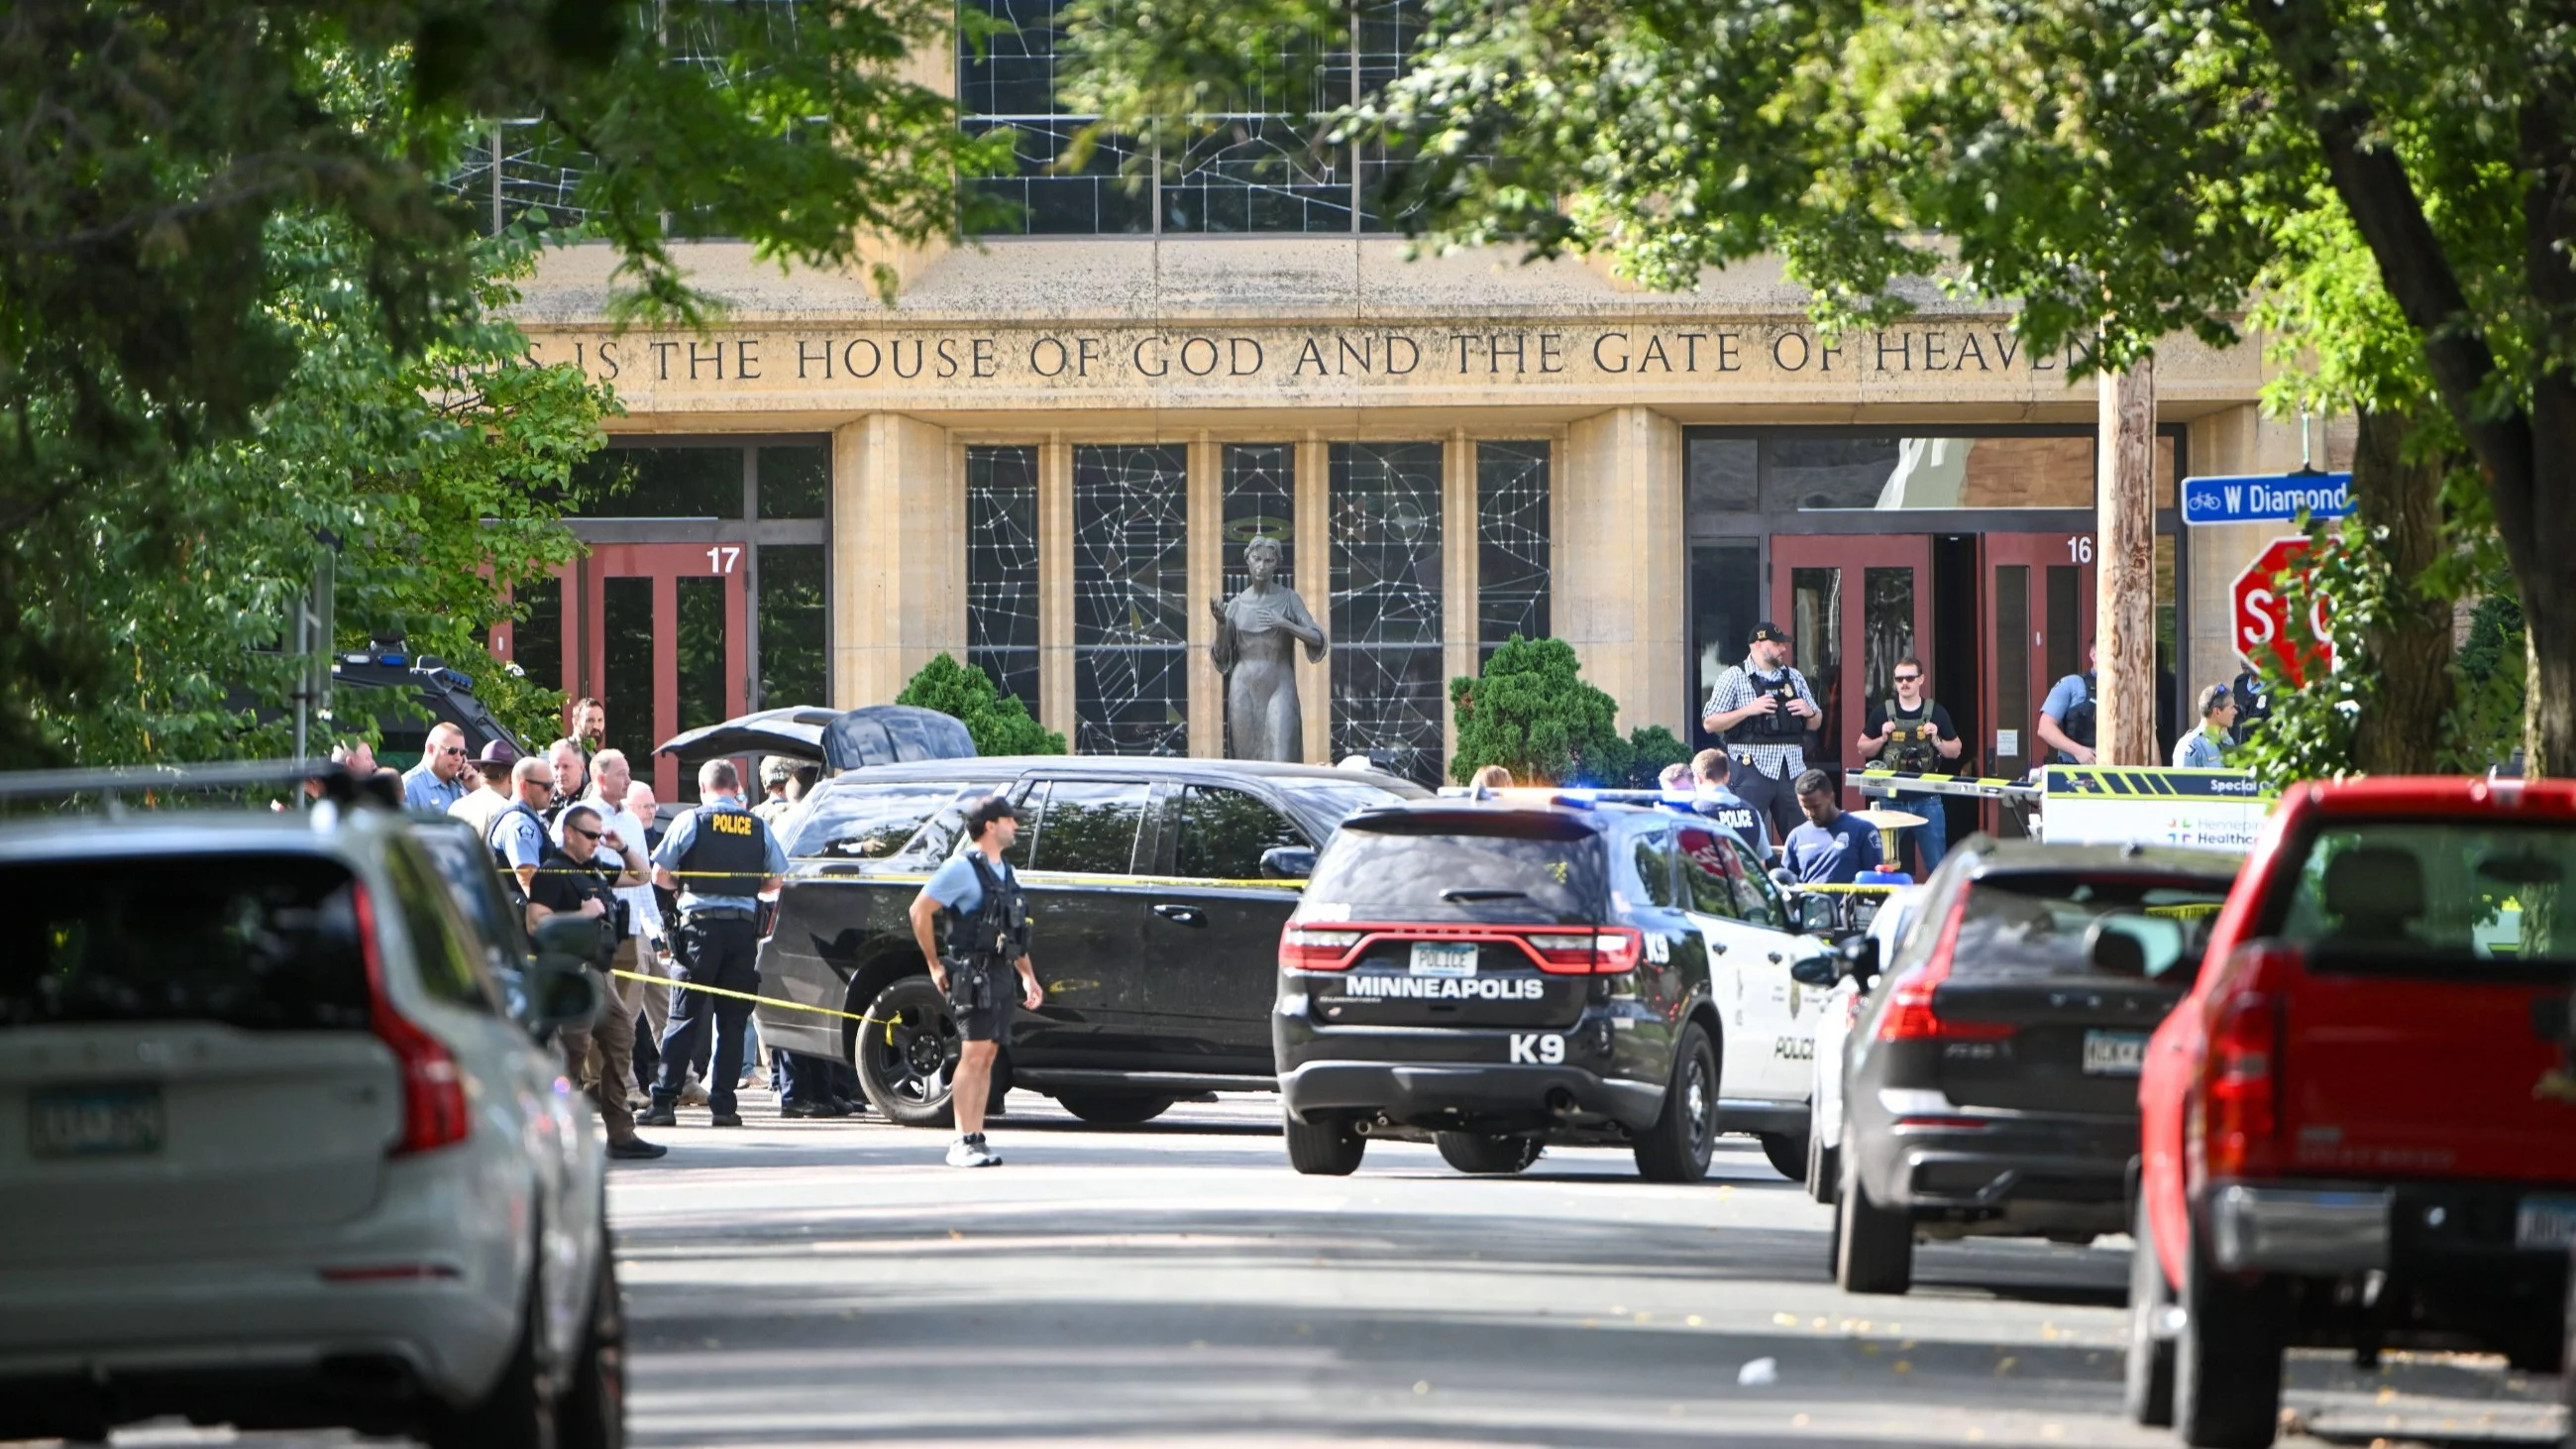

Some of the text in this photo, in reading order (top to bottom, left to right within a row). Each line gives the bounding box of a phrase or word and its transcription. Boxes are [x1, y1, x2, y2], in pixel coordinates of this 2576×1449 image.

[576, 341, 620, 381] IS
[649, 339, 762, 381] THE
[795, 338, 996, 380] HOUSE
[1029, 337, 1100, 377] OF
[1132, 337, 1264, 378] GOD
[1292, 336, 1421, 376] AND
[1449, 334, 1564, 374] THE
[1592, 332, 1743, 373] GATE
[1772, 332, 1843, 372] OF
[2223, 482, 2348, 514] W Diamond
[706, 547, 740, 574] 17
[2067, 536, 2093, 564] 16
[2210, 778, 2258, 793] Special
[712, 813, 752, 836] POLICE
[1718, 809, 1754, 829] POLICE
[1419, 949, 1467, 969] POLICE
[1644, 932, 1670, 964] K9
[1345, 975, 1545, 1000] MINNEAPOLIS
[1509, 1034, 1566, 1065] K9
